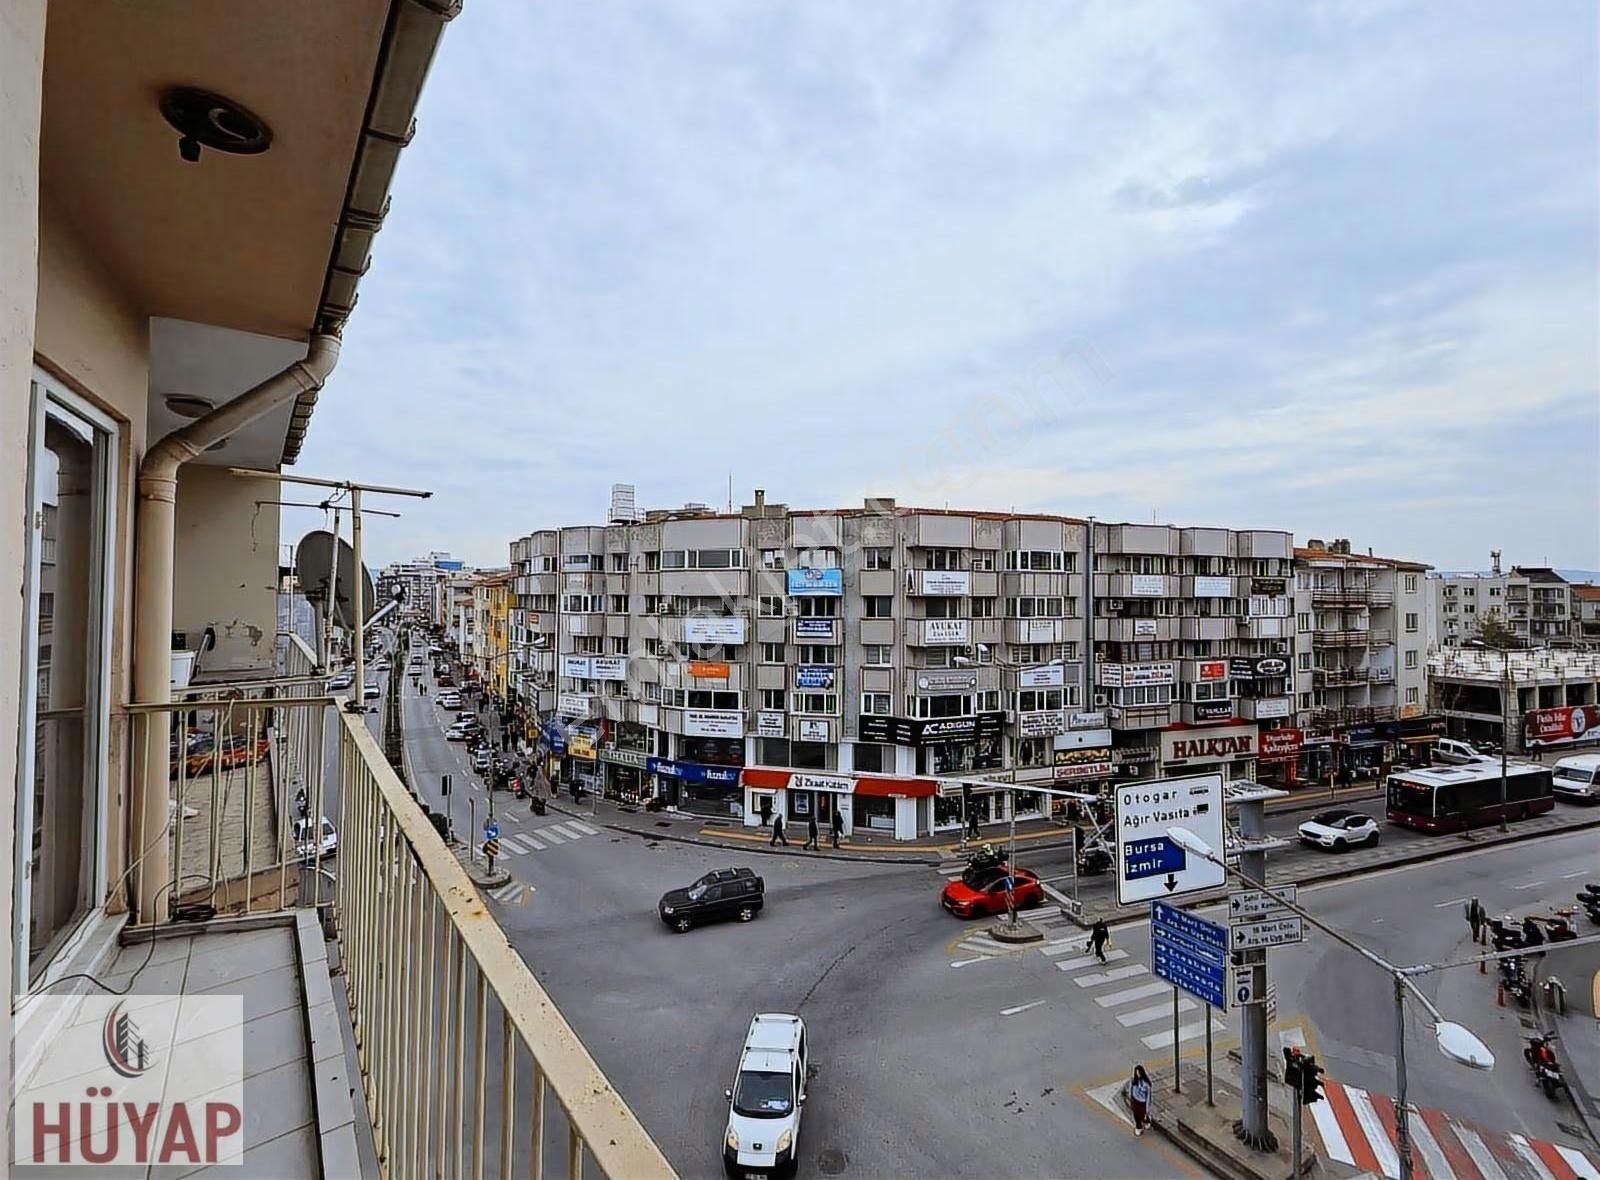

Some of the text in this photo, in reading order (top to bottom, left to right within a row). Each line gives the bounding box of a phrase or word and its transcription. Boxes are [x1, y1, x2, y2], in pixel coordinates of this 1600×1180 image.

[1123, 789, 1179, 806] Otogar
[1123, 809, 1190, 828] Ağır Vasıta
[1124, 842, 1165, 857] Bursa
